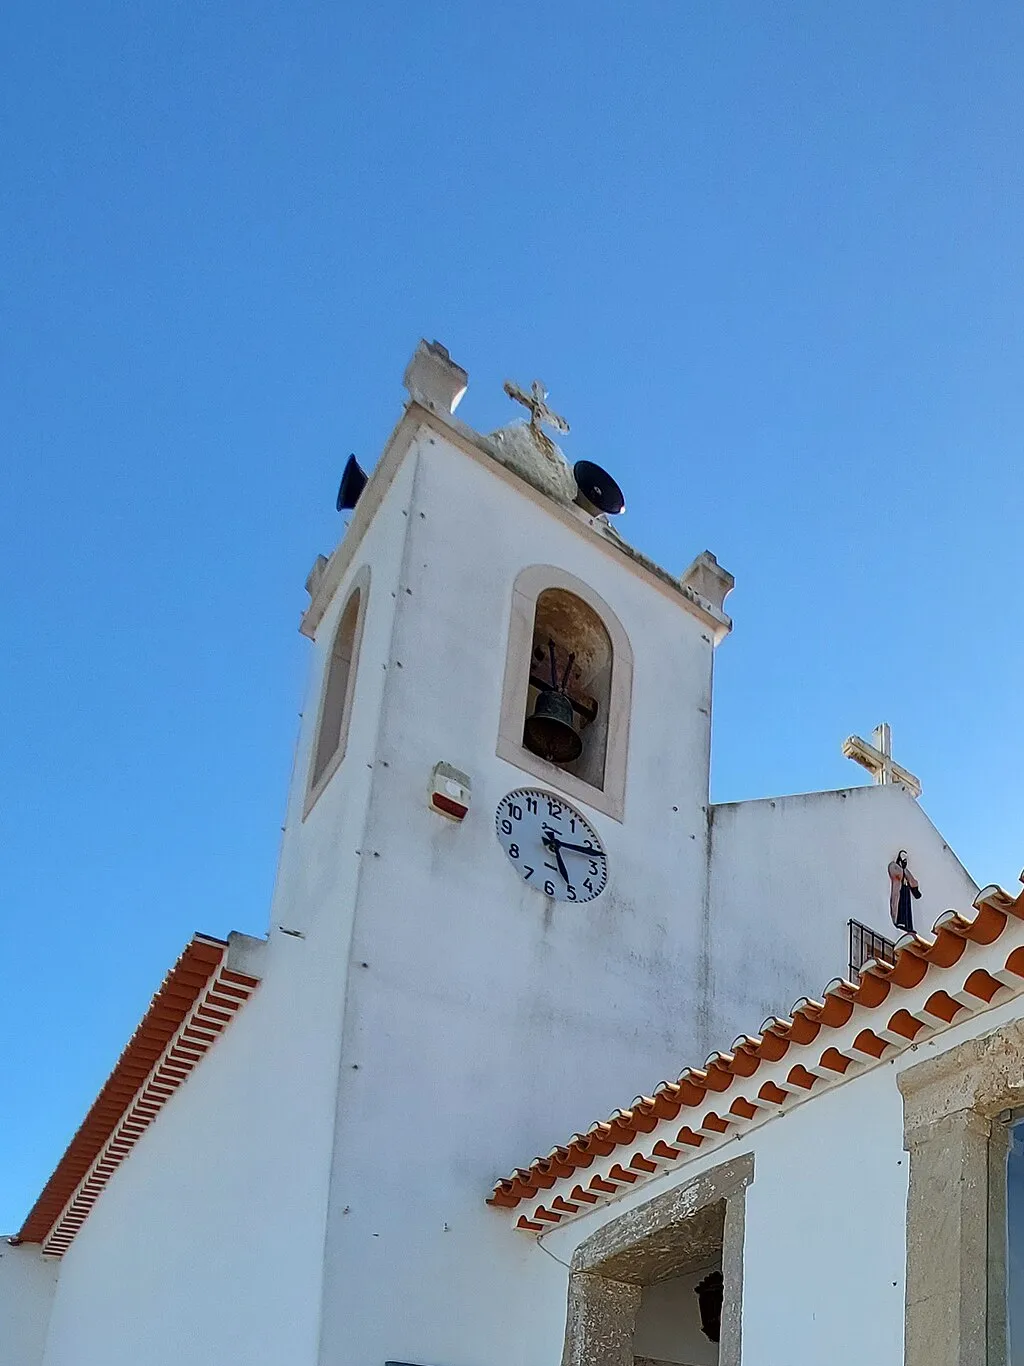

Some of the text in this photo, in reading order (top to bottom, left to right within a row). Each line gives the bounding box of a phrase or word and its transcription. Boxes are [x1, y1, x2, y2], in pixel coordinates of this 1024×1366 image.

[508, 803, 522, 820] 10
[526, 797, 537, 815] 11
[547, 802, 561, 820] 12
[501, 820, 512, 834] 9
[570, 819, 575, 833] 1
[509, 844, 519, 858] 8
[524, 865, 534, 879] 7
[589, 860, 598, 875] 3
[544, 881, 555, 895] 6
[567, 885, 576, 900] 5
[583, 878, 593, 893] 4
